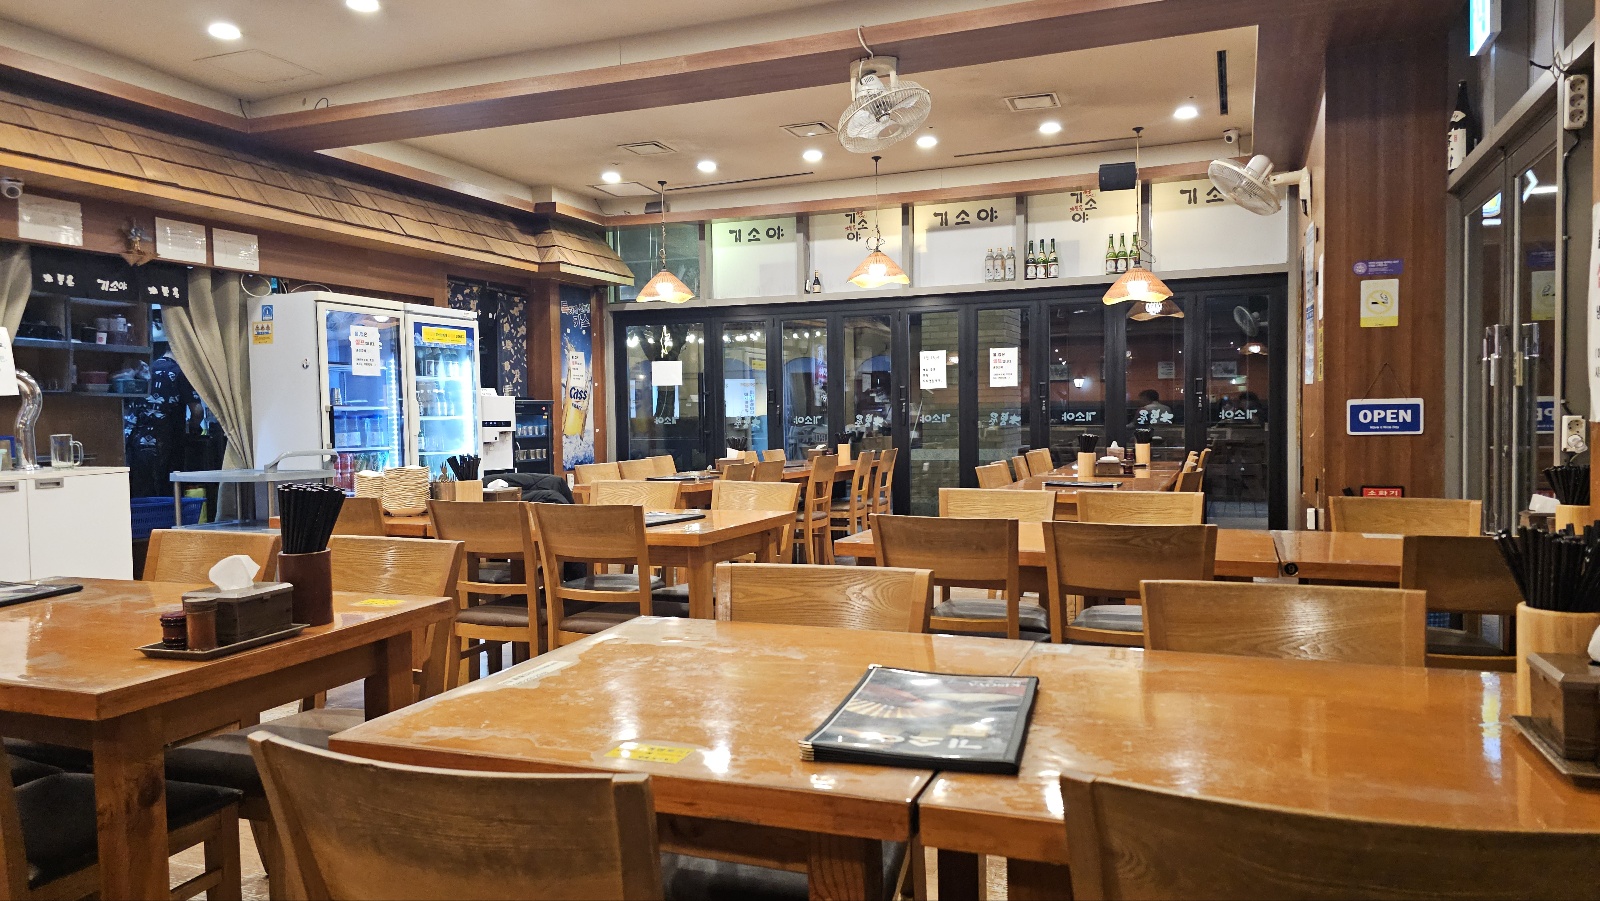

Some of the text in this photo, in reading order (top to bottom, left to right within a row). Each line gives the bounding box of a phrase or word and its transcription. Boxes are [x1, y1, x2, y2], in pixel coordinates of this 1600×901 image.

[933, 206, 999, 227] 기소야
[728, 225, 785, 243] 기소야
[96, 278, 128, 292] 기소야
[1358, 409, 1412, 423] OPEN
